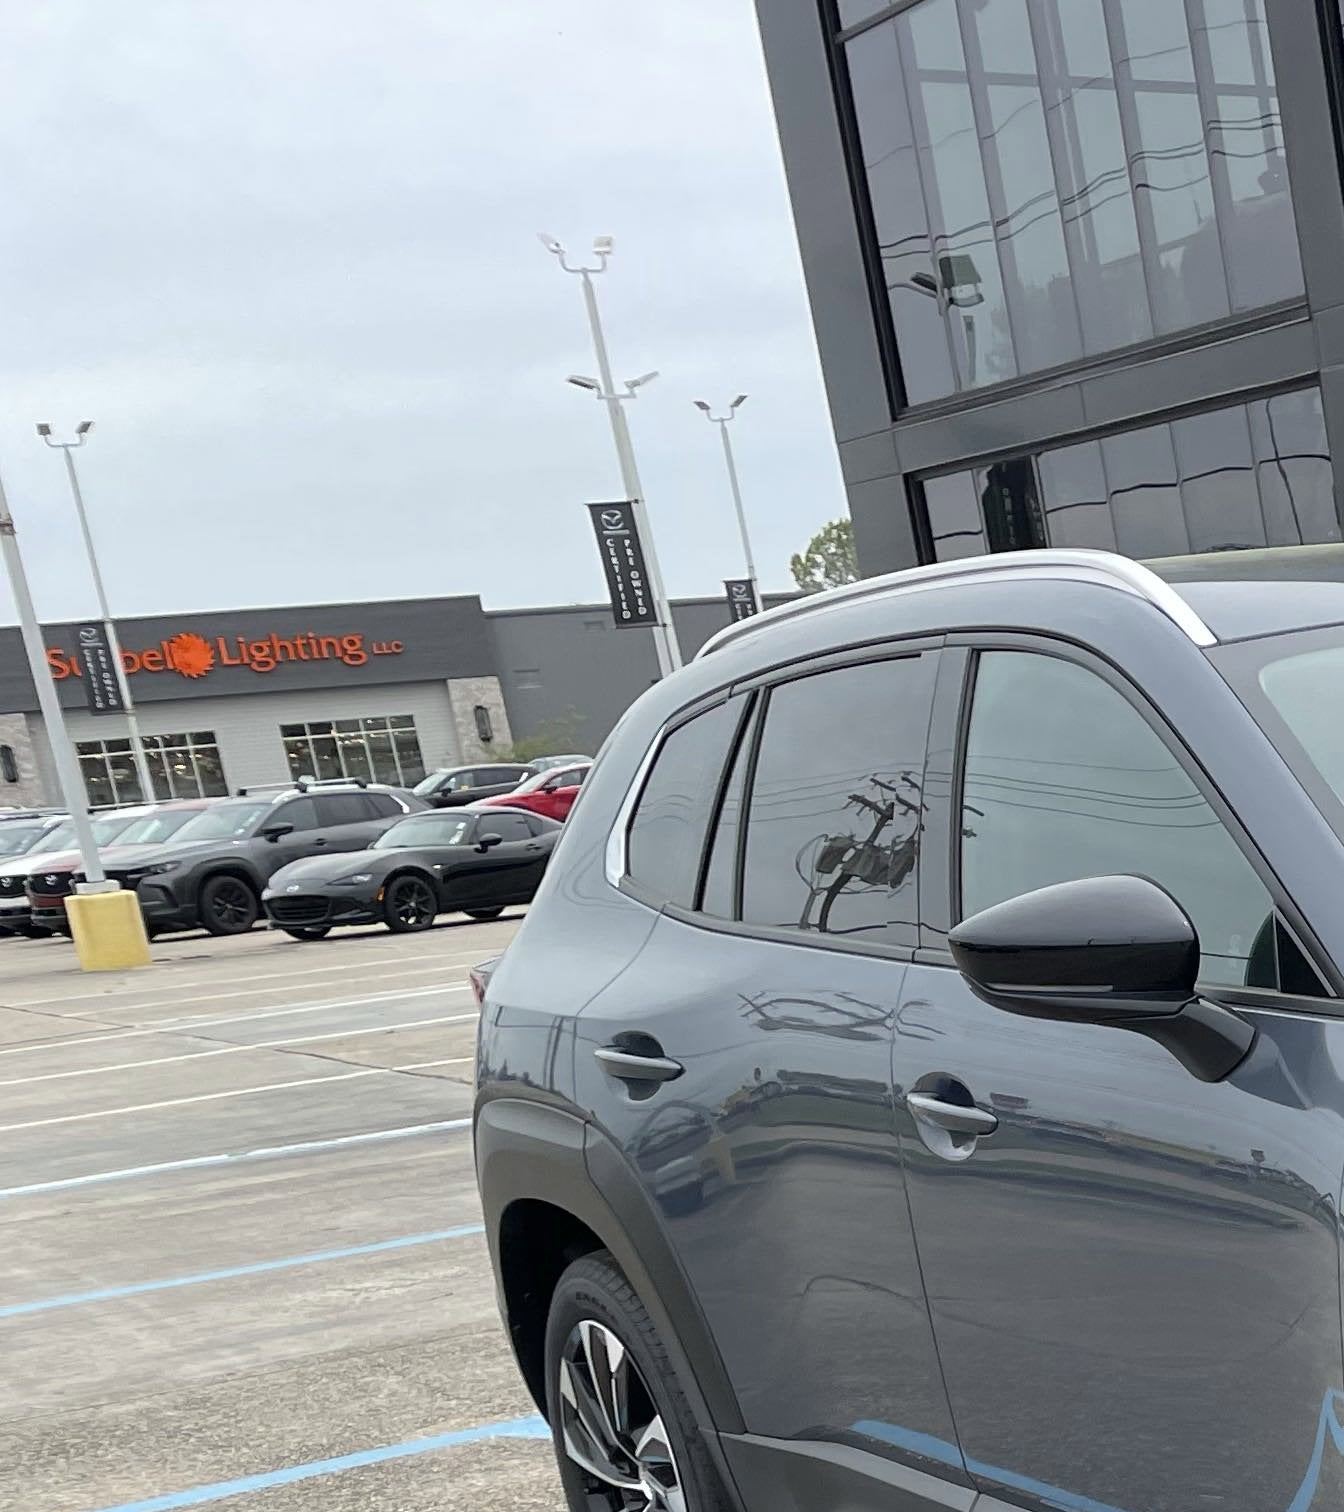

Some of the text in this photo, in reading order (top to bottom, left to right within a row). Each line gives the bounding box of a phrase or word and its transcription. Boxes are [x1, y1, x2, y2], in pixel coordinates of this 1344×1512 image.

[606, 538, 632, 619] CERTIFIED
[624, 539, 648, 615] PRE OWNED
[216, 631, 369, 673] Lighting
[372, 640, 405, 656] LLC
